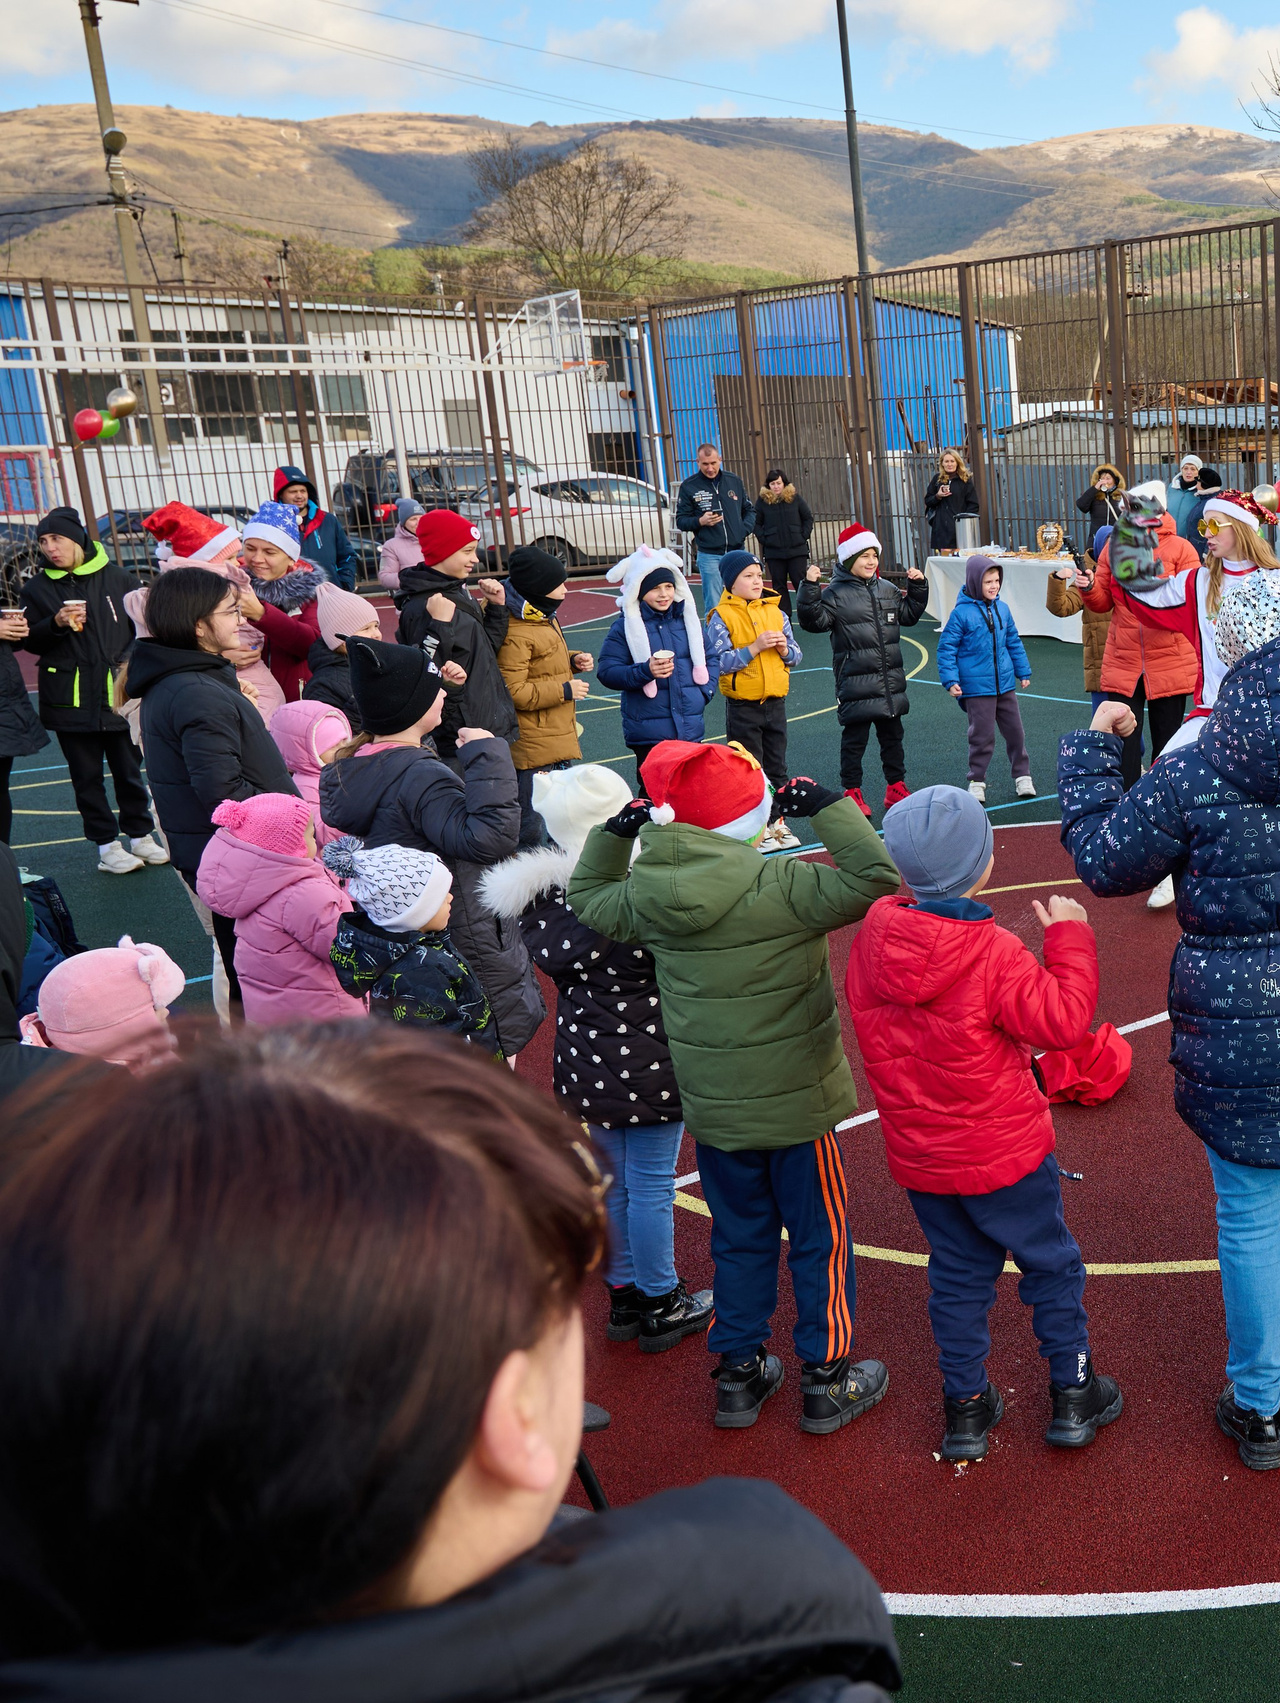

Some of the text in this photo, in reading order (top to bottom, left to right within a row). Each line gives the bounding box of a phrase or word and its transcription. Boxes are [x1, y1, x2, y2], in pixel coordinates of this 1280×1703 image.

[1193, 792, 1219, 806] DANCE
[1264, 821, 1276, 834] BE
[1254, 883, 1274, 898] GIRL
[1203, 903, 1226, 914] DANCE
[1259, 977, 1279, 994] GIRL
[1266, 988, 1280, 998] PWR
[1210, 998, 1233, 1009] DANCE
[1228, 1039, 1242, 1048] PARTY
[1214, 1102, 1237, 1112] DANCE
